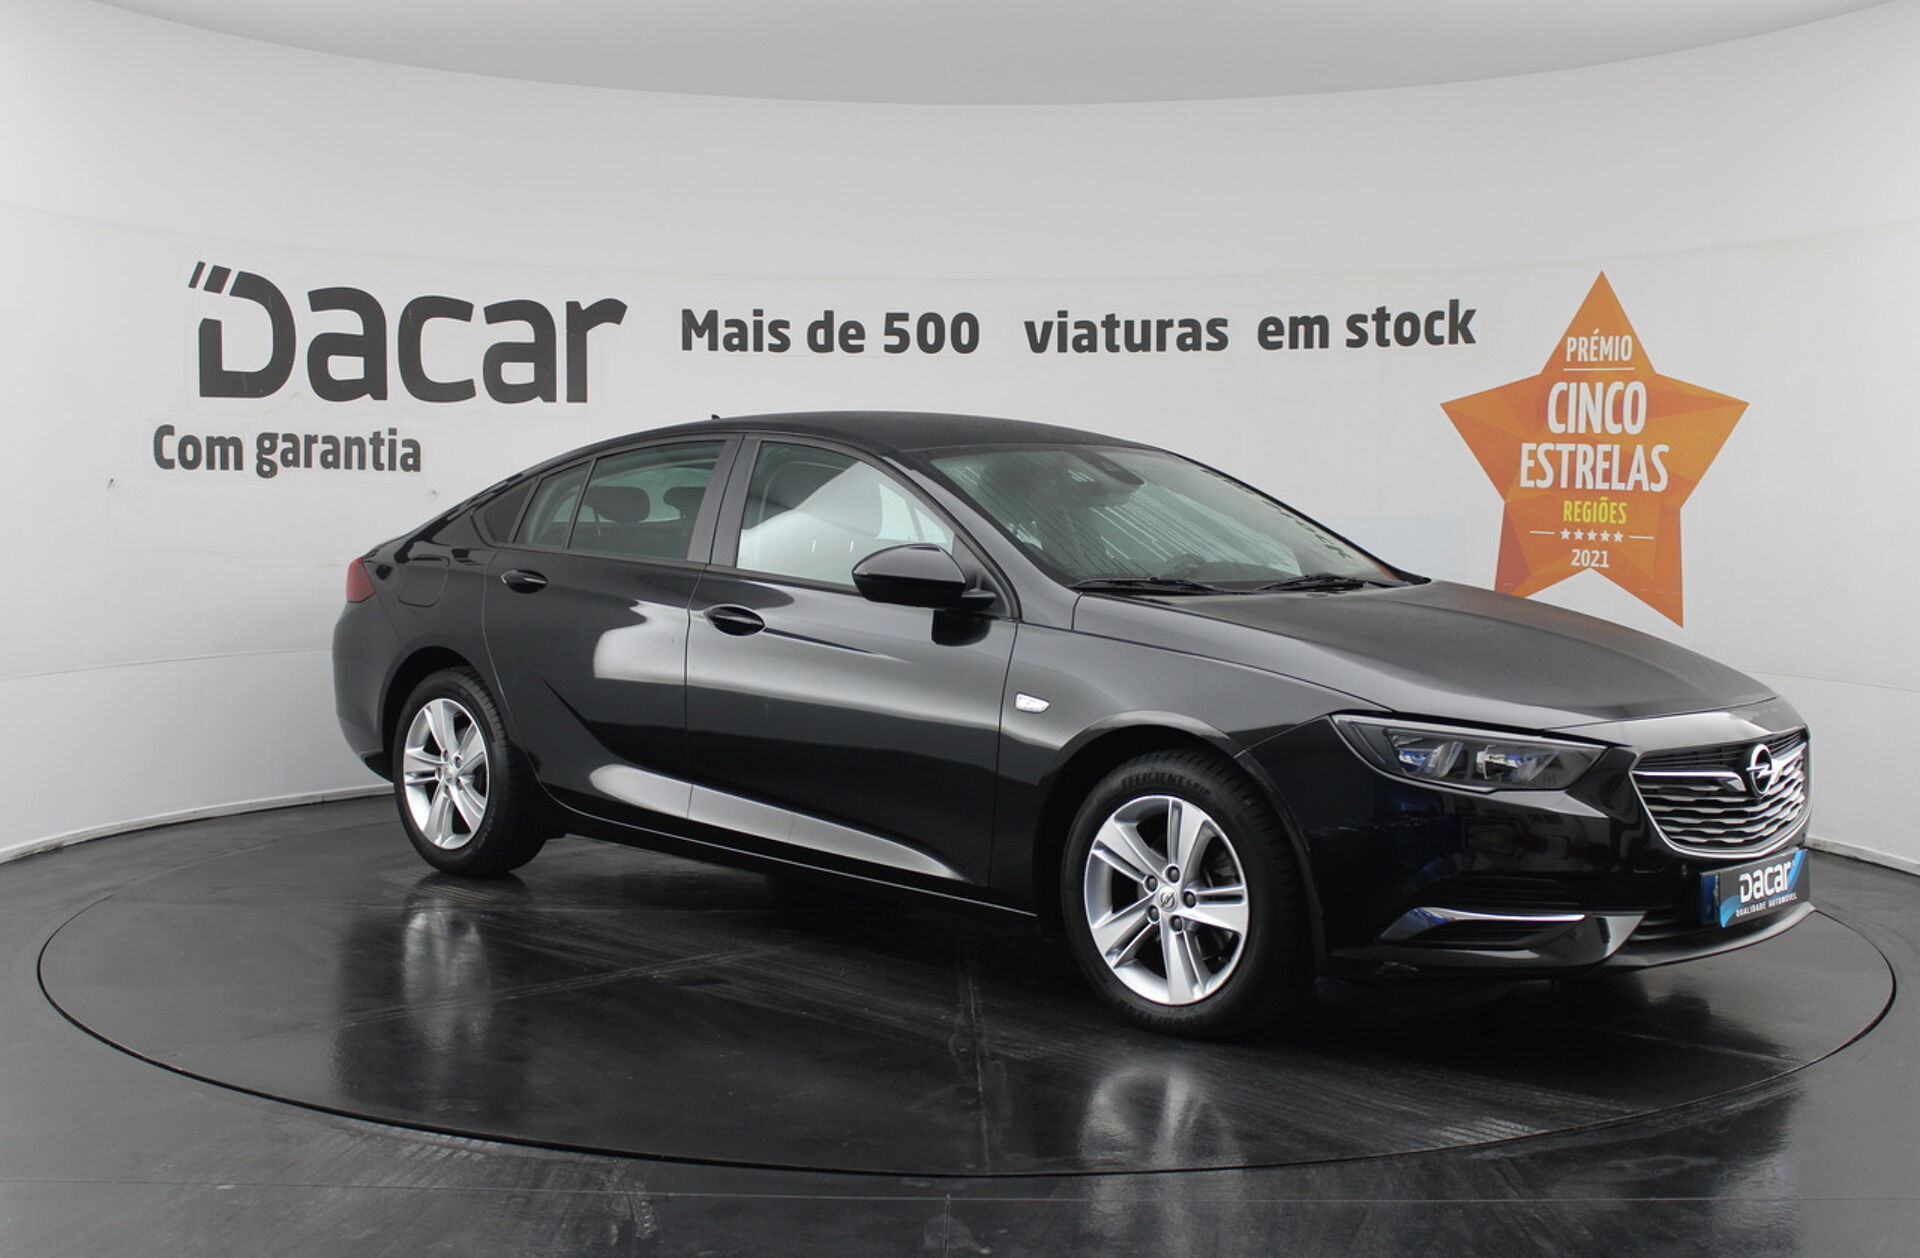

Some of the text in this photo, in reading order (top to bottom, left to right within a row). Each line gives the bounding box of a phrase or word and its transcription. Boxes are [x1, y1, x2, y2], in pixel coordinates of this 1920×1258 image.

[188, 261, 627, 403] Dacar
[682, 298, 1477, 355] Mais de 500 viaturas em stock
[1565, 328, 1633, 362] PRÉMIO
[1548, 381, 1646, 434] CINCO
[153, 424, 421, 479] Com garantia
[1520, 443, 1669, 492] ESTRELAS
[1563, 496, 1627, 525] REGIÕES
[1571, 549, 1610, 568] 2021
[1739, 861, 1791, 903] Dacar
